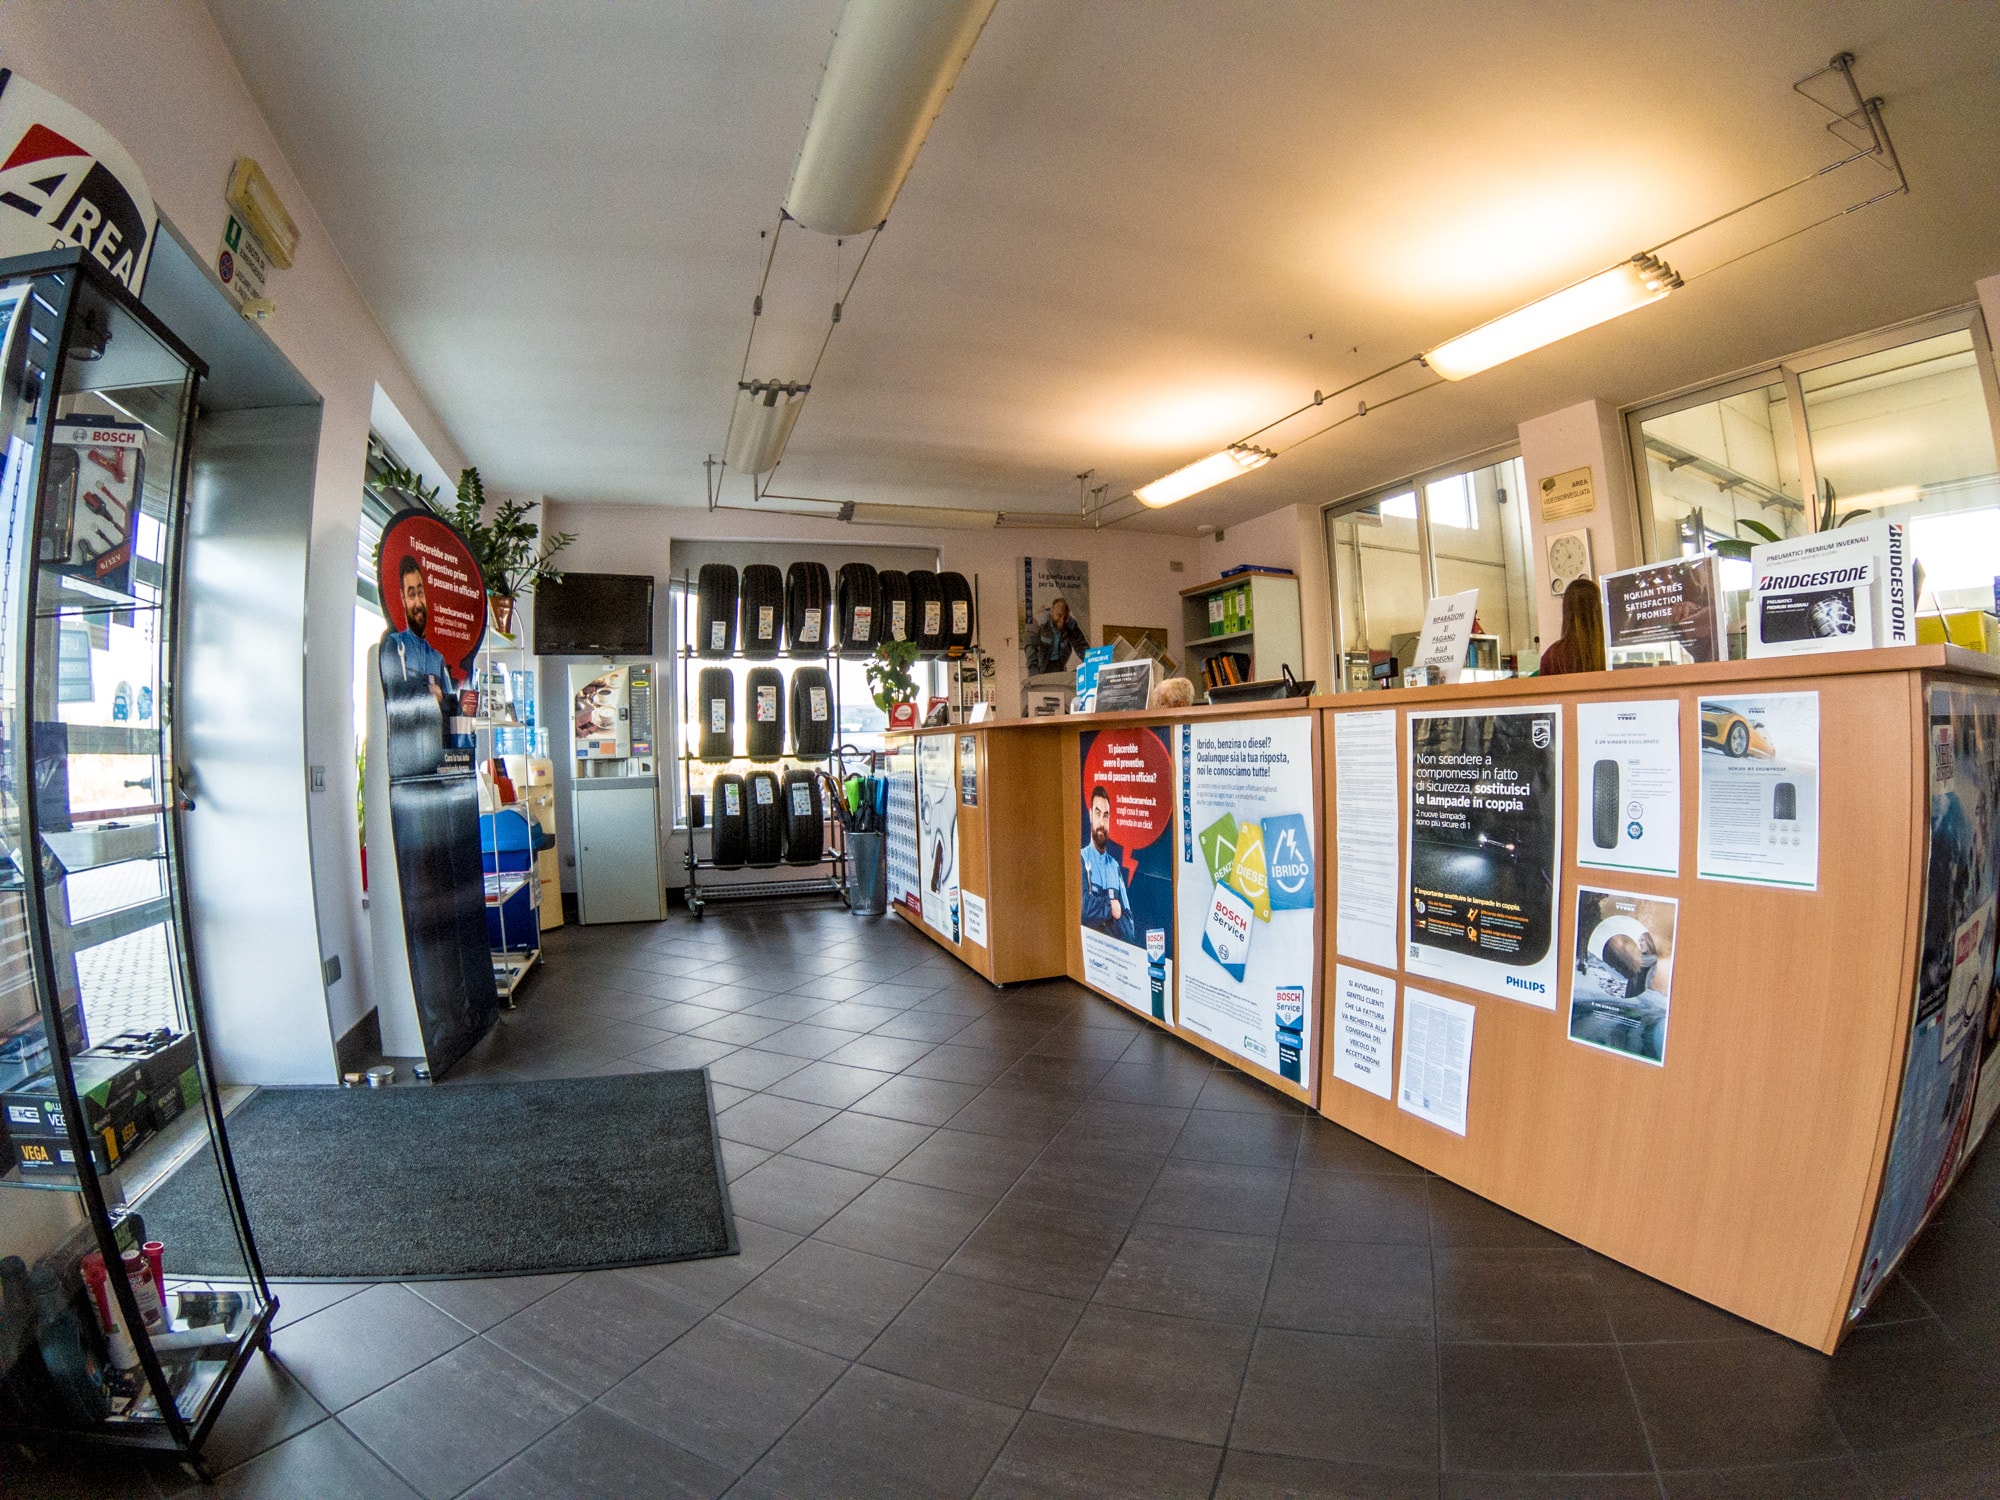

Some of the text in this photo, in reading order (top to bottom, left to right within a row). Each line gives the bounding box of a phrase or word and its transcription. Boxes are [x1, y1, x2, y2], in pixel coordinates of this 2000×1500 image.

[92, 430, 136, 444] BOSCH
[1572, 479, 1588, 488] AREA
[1544, 488, 1590, 505] VIDEOSORVEGLIATA
[410, 536, 458, 564] Ti piacerebbe avere
[1766, 551, 1803, 562] PNEUMATICI
[1804, 544, 1834, 554] PREMIUM
[1836, 536, 1869, 548] INVERNALI
[100, 554, 122, 570] 6/12V
[426, 560, 453, 577] preventivo
[454, 571, 467, 582] prima
[1759, 566, 1868, 591] BRIDGESTONE
[428, 574, 480, 599] di passare in officina?
[1889, 524, 1906, 642] BRIDGESTONE
[1624, 583, 1683, 601] NOKIAN TYRES
[1448, 604, 1454, 612] LE
[1625, 595, 1683, 612] SATISFACTION
[1433, 613, 1465, 623] RIPARAZIONI
[1637, 608, 1672, 620] PROMISE
[1108, 743, 1138, 755] Ti piacerebbe
[1197, 737, 1271, 750] Ibrido, benzina o diesel?
[1117, 758, 1120, 767] il
[1120, 758, 1144, 769] preventivo
[1197, 752, 1289, 765] Qualunque sia la tua risposta,
[1416, 753, 1492, 765] Non scendere a
[1094, 771, 1156, 783] prima di passare in officina?
[1197, 766, 1270, 777] noi le conosciamo tutte!
[1416, 768, 1518, 781] compromessi in fatto
[1416, 781, 1530, 796] di sicurezza, sostituisci
[1416, 794, 1524, 812] le lampade in coppia
[1431, 820, 1440, 828] più
[1439, 812, 1466, 821] lampade
[1236, 864, 1268, 888] DIESEL
[1272, 863, 1309, 878] IBRIDO
[1419, 888, 1443, 898] importante
[1444, 892, 1466, 902] sostituire
[1472, 897, 1495, 907] lampade
[1502, 902, 1521, 911] coppia.
[1216, 901, 1247, 931] BOSCH
[1213, 912, 1245, 942] Service
[1148, 934, 1163, 942] BOSCH
[1354, 982, 1379, 994] AVVISANO
[1506, 976, 1545, 993] PHILIPS
[1277, 992, 1300, 1002] BOSCH
[1346, 991, 1384, 1008] GENTILI CLIENTI
[1276, 1003, 1300, 1012] Service
[1345, 1002, 1354, 1010] CHE
[1363, 1007, 1384, 1020] FATTURA
[1350, 1015, 1373, 1028] RICHIESTA
[1375, 1024, 1387, 1033] ALLA
[1346, 1026, 1381, 1044] CONSEGNA DEL
[1350, 1038, 1369, 1050] VEICOLO
[1345, 1048, 1380, 1066] ACCETTAZIONE
[48, 1114, 67, 1126] VEG
[21, 1145, 49, 1160] VEGA
